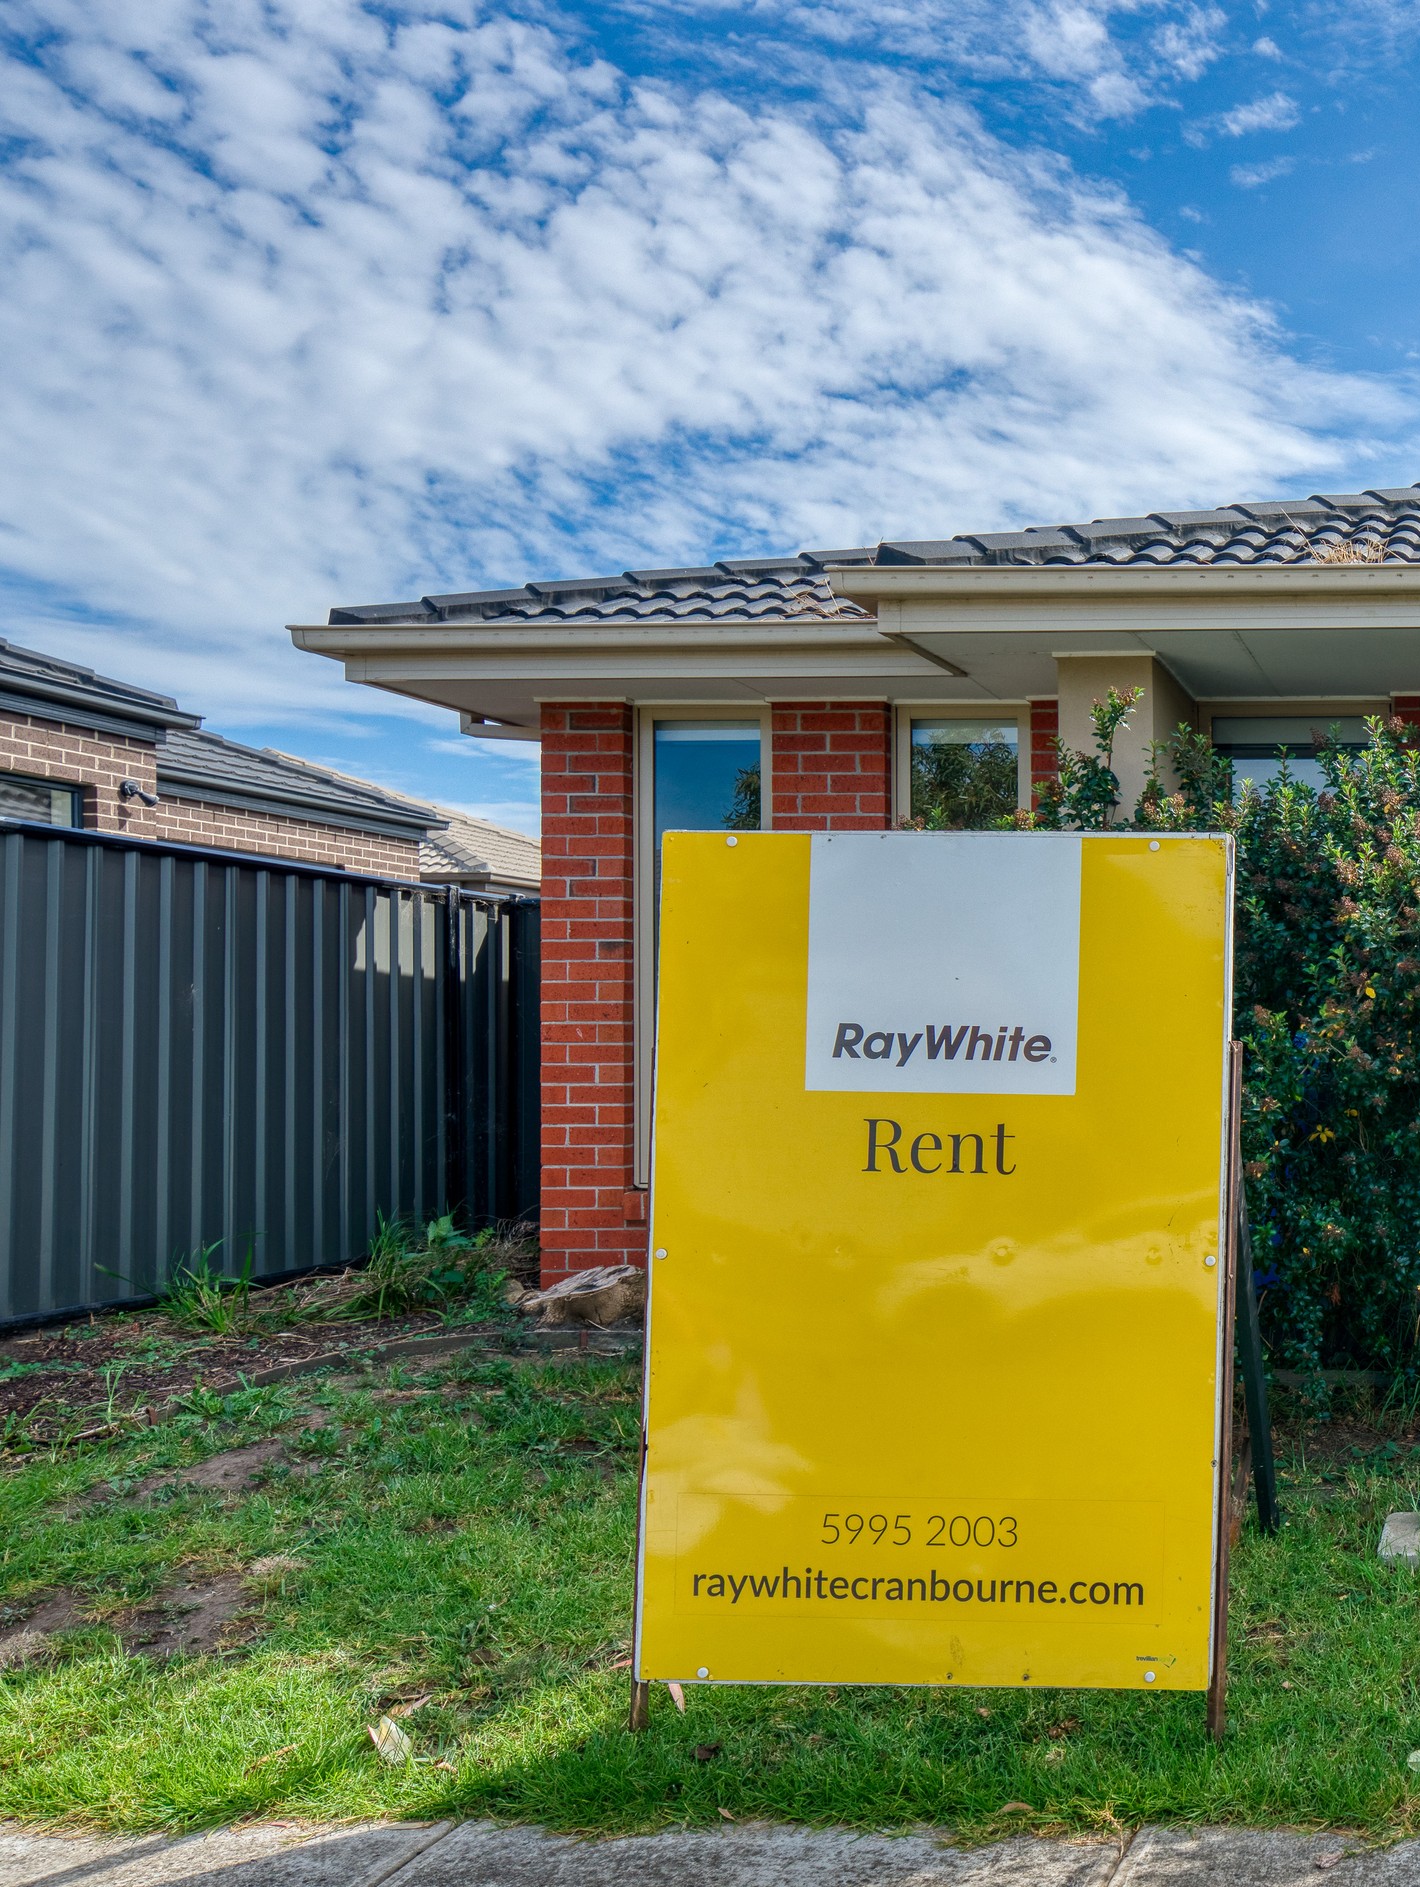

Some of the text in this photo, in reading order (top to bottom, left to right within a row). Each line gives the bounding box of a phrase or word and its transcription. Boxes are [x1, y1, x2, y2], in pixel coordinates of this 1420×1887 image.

[832, 1022, 1053, 1067] RayWhite
[861, 1118, 1017, 1176] Rent
[821, 1513, 1019, 1548] 5995 2003
[692, 1567, 1145, 1606] raywhitecranbourne.com
